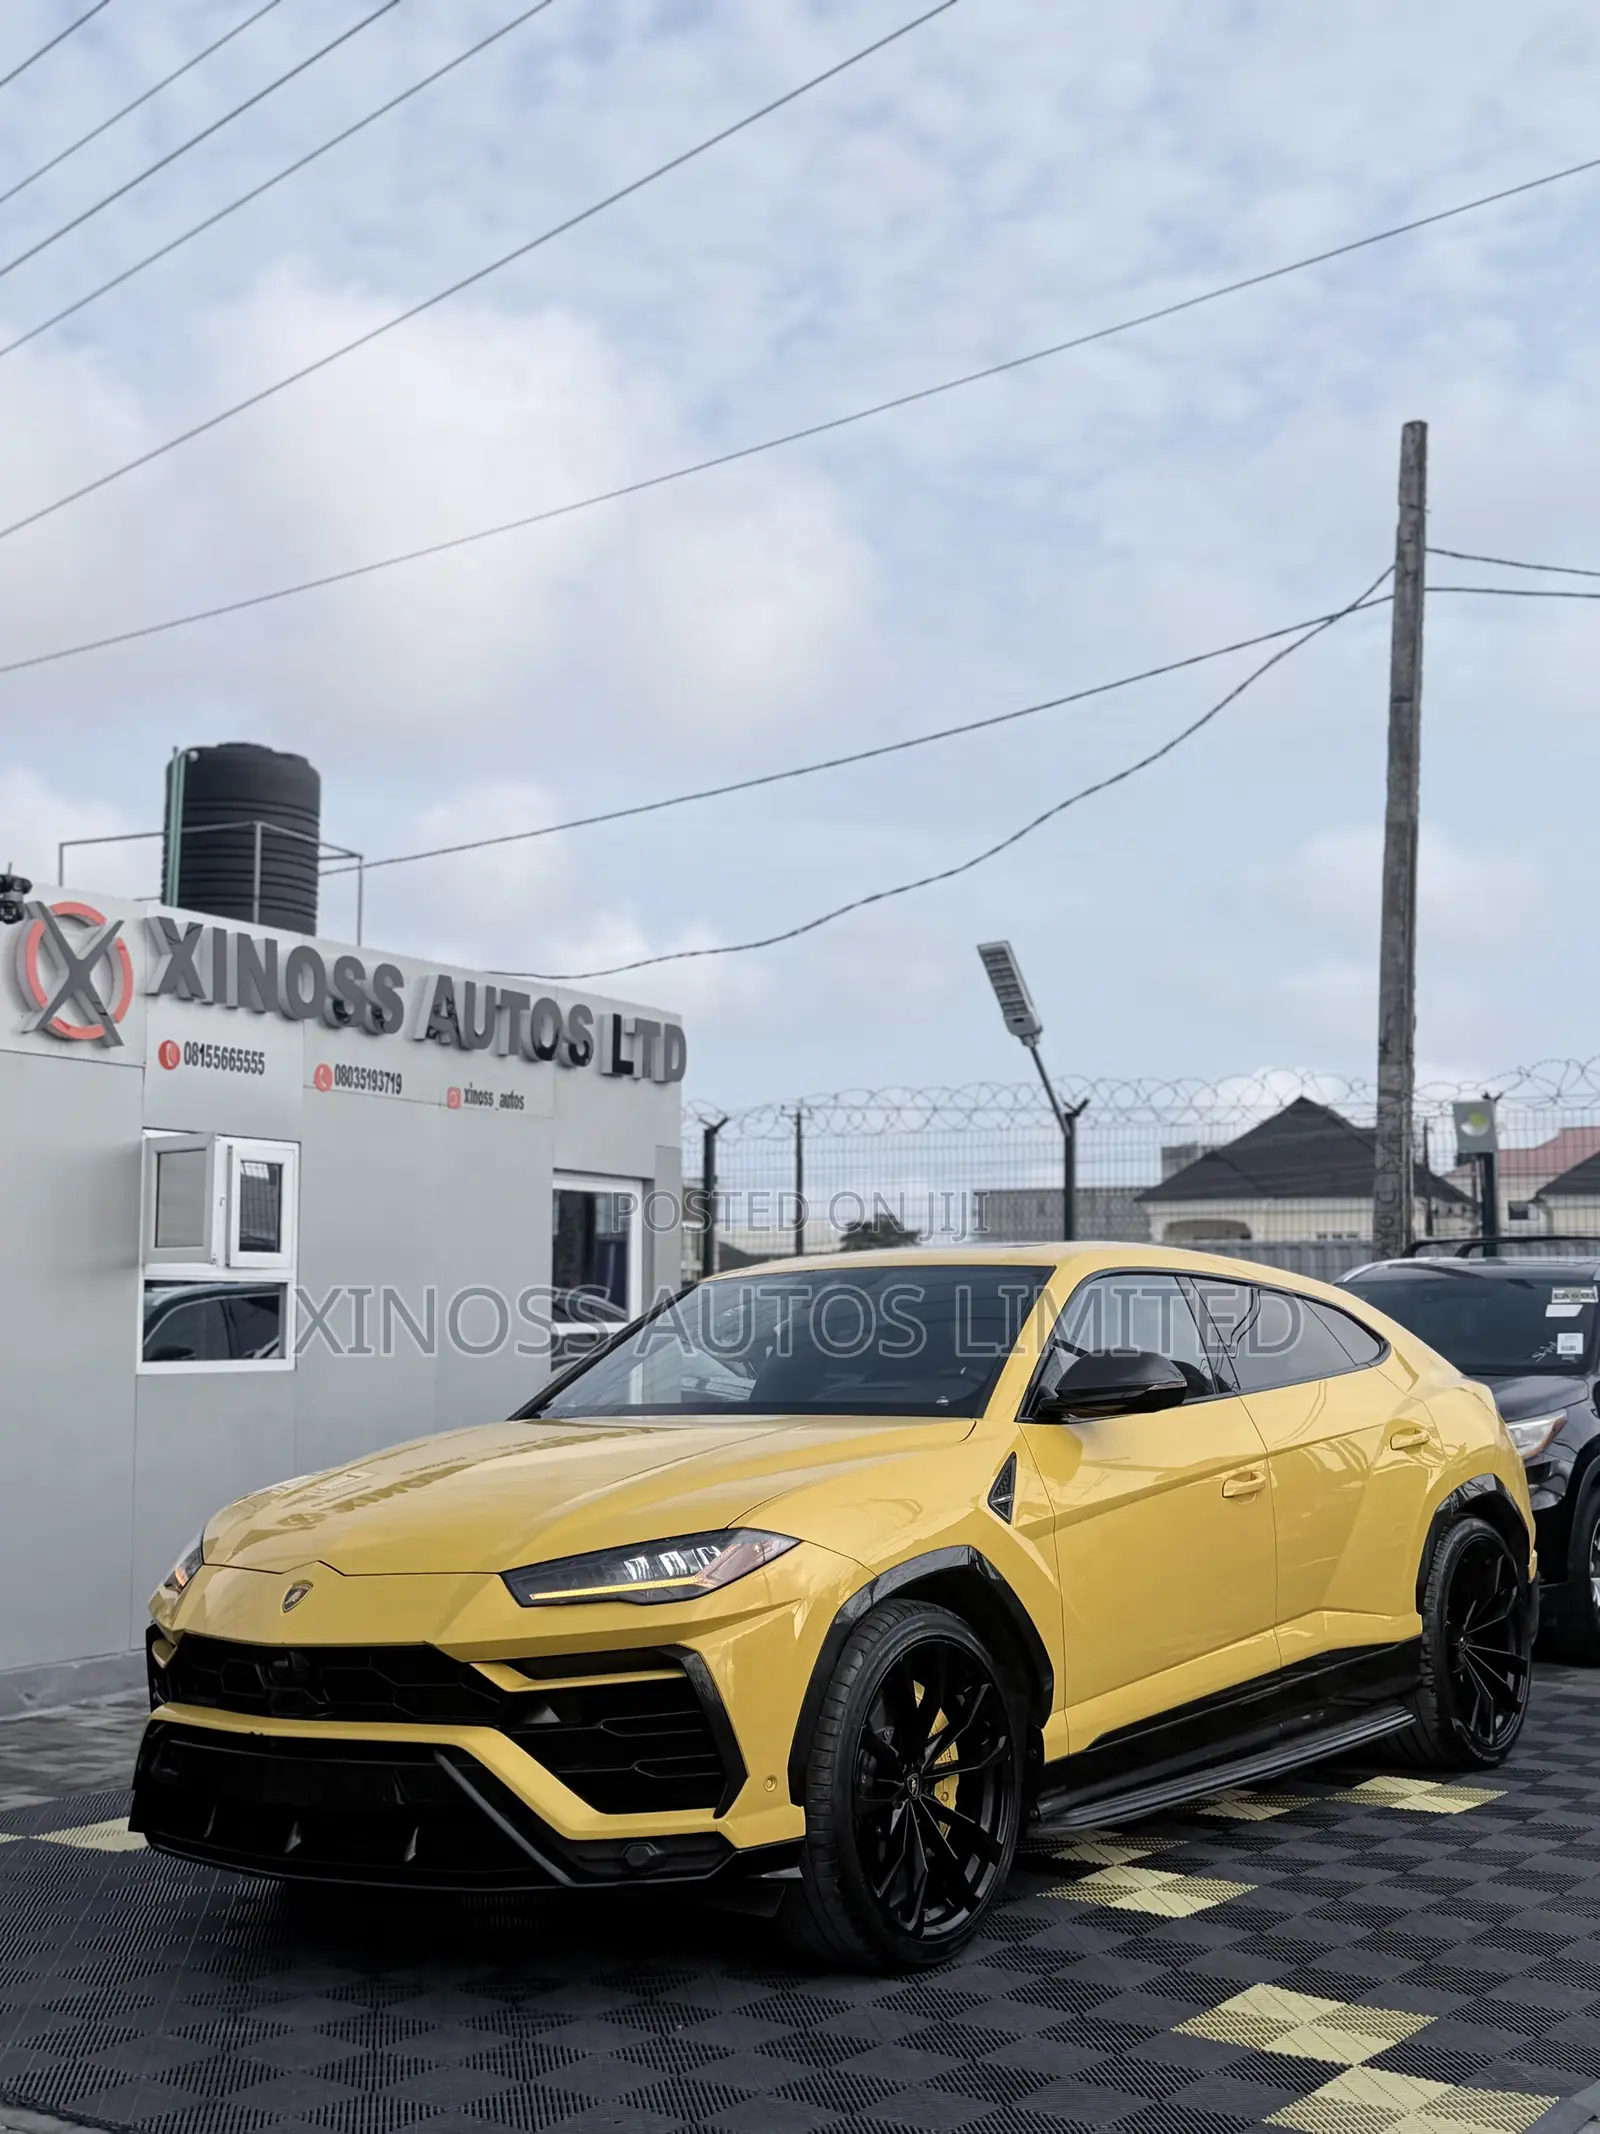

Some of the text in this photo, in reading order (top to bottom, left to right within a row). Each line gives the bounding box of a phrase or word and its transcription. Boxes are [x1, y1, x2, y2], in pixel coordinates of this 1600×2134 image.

[145, 915, 687, 1083] XINOSS AUTOS LTD
[183, 1040, 266, 1076] 08155665555
[334, 1063, 403, 1095] 08035193719
